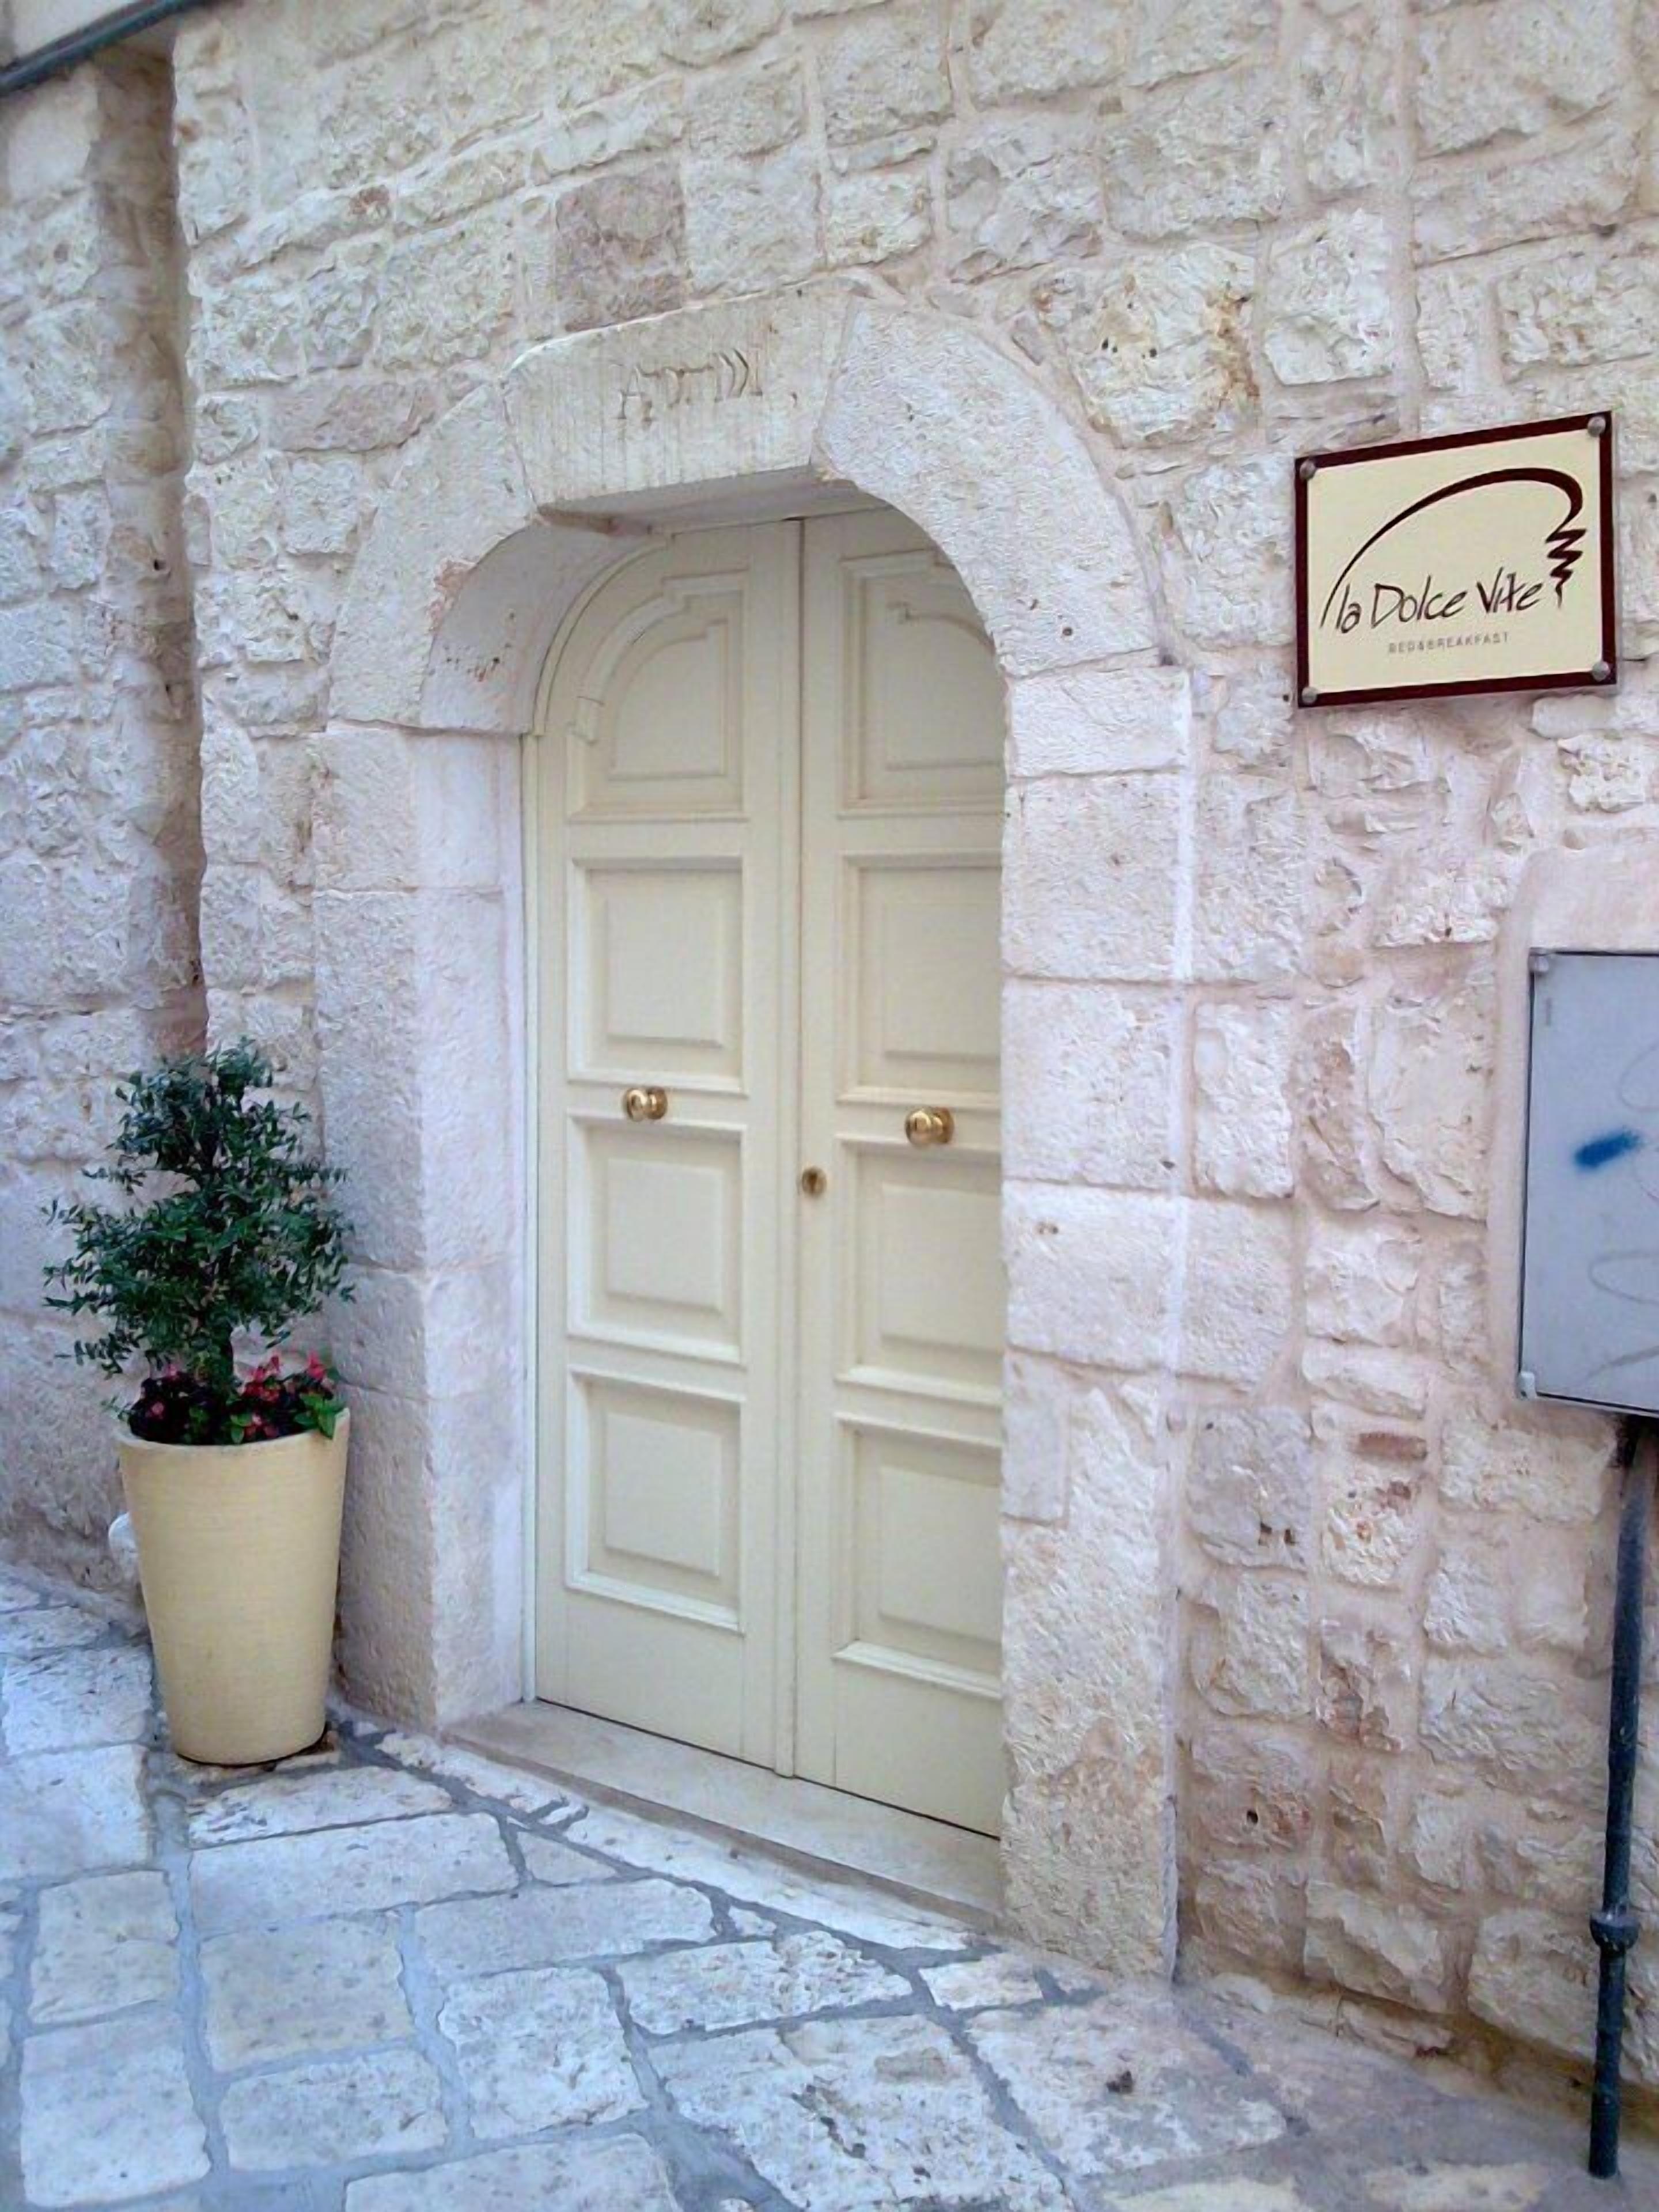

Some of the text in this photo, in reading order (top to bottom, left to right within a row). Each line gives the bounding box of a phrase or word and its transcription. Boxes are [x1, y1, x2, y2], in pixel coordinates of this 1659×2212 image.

[1335, 566, 1543, 633] la Dolce Vite
[1389, 631, 1509, 653] BED&BREAKFAST
